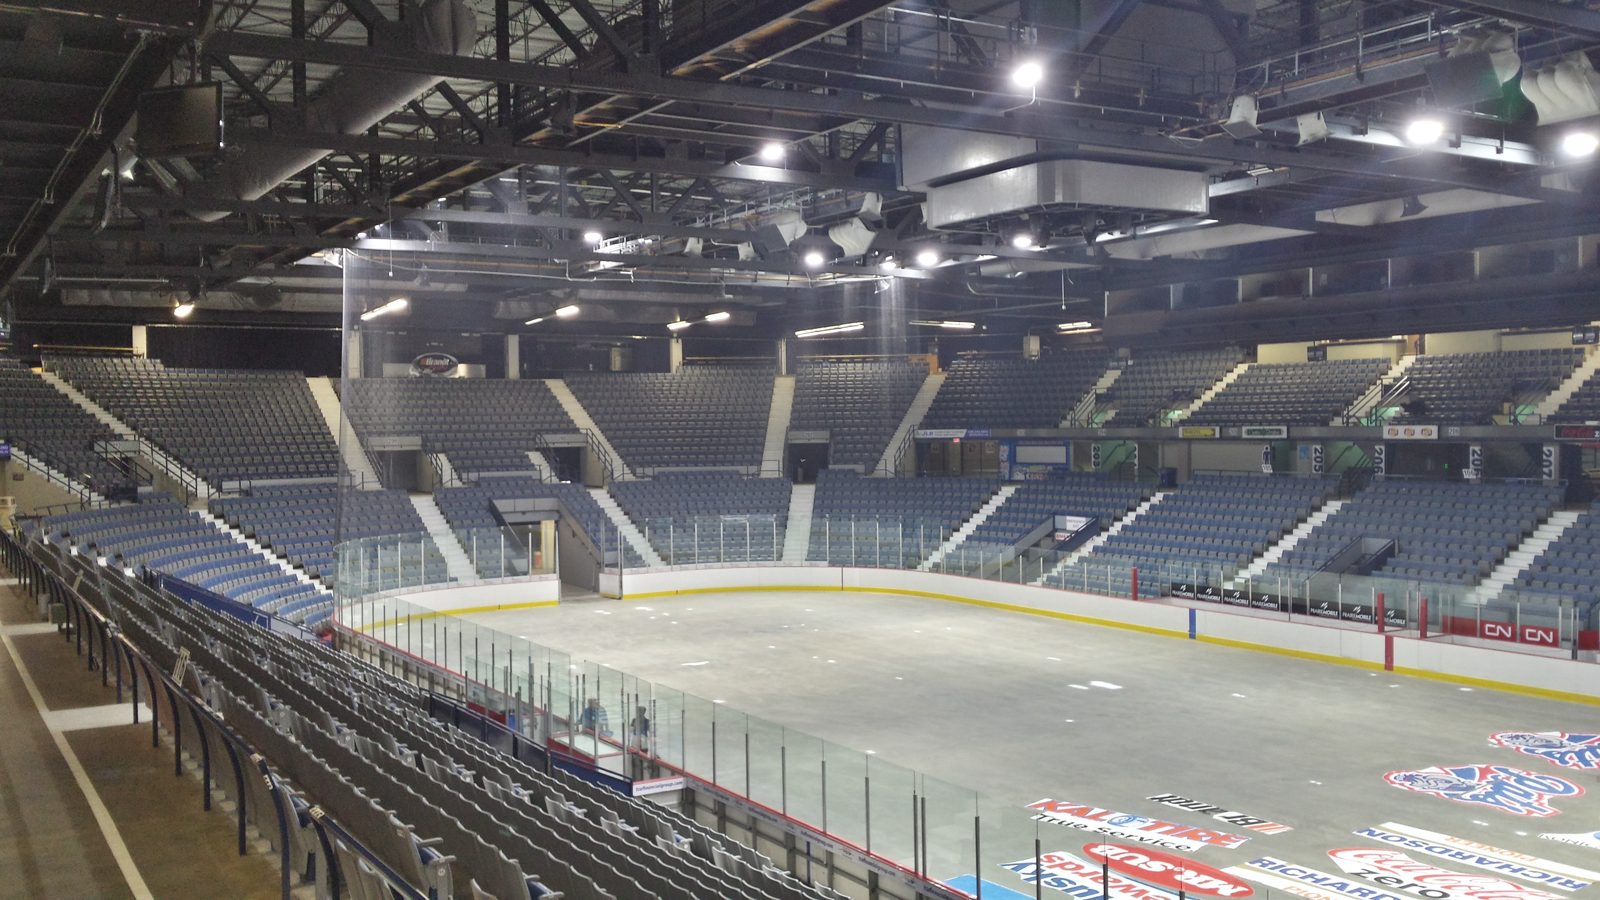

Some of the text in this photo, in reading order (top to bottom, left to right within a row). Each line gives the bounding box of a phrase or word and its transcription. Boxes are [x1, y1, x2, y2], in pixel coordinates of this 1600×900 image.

[1313, 445, 1323, 473] 205
[1374, 445, 1384, 475] 206
[1543, 446, 1553, 479] 207
[1485, 623, 1511, 638] CN
[1525, 629, 1553, 643] CN
[1026, 799, 1249, 848] KAL TIRE
[1356, 827, 1589, 890] RICHARDSON
[1444, 836, 1537, 862] PIONEER
[1001, 862, 1115, 900] usky
[1350, 868, 1450, 899] zero
